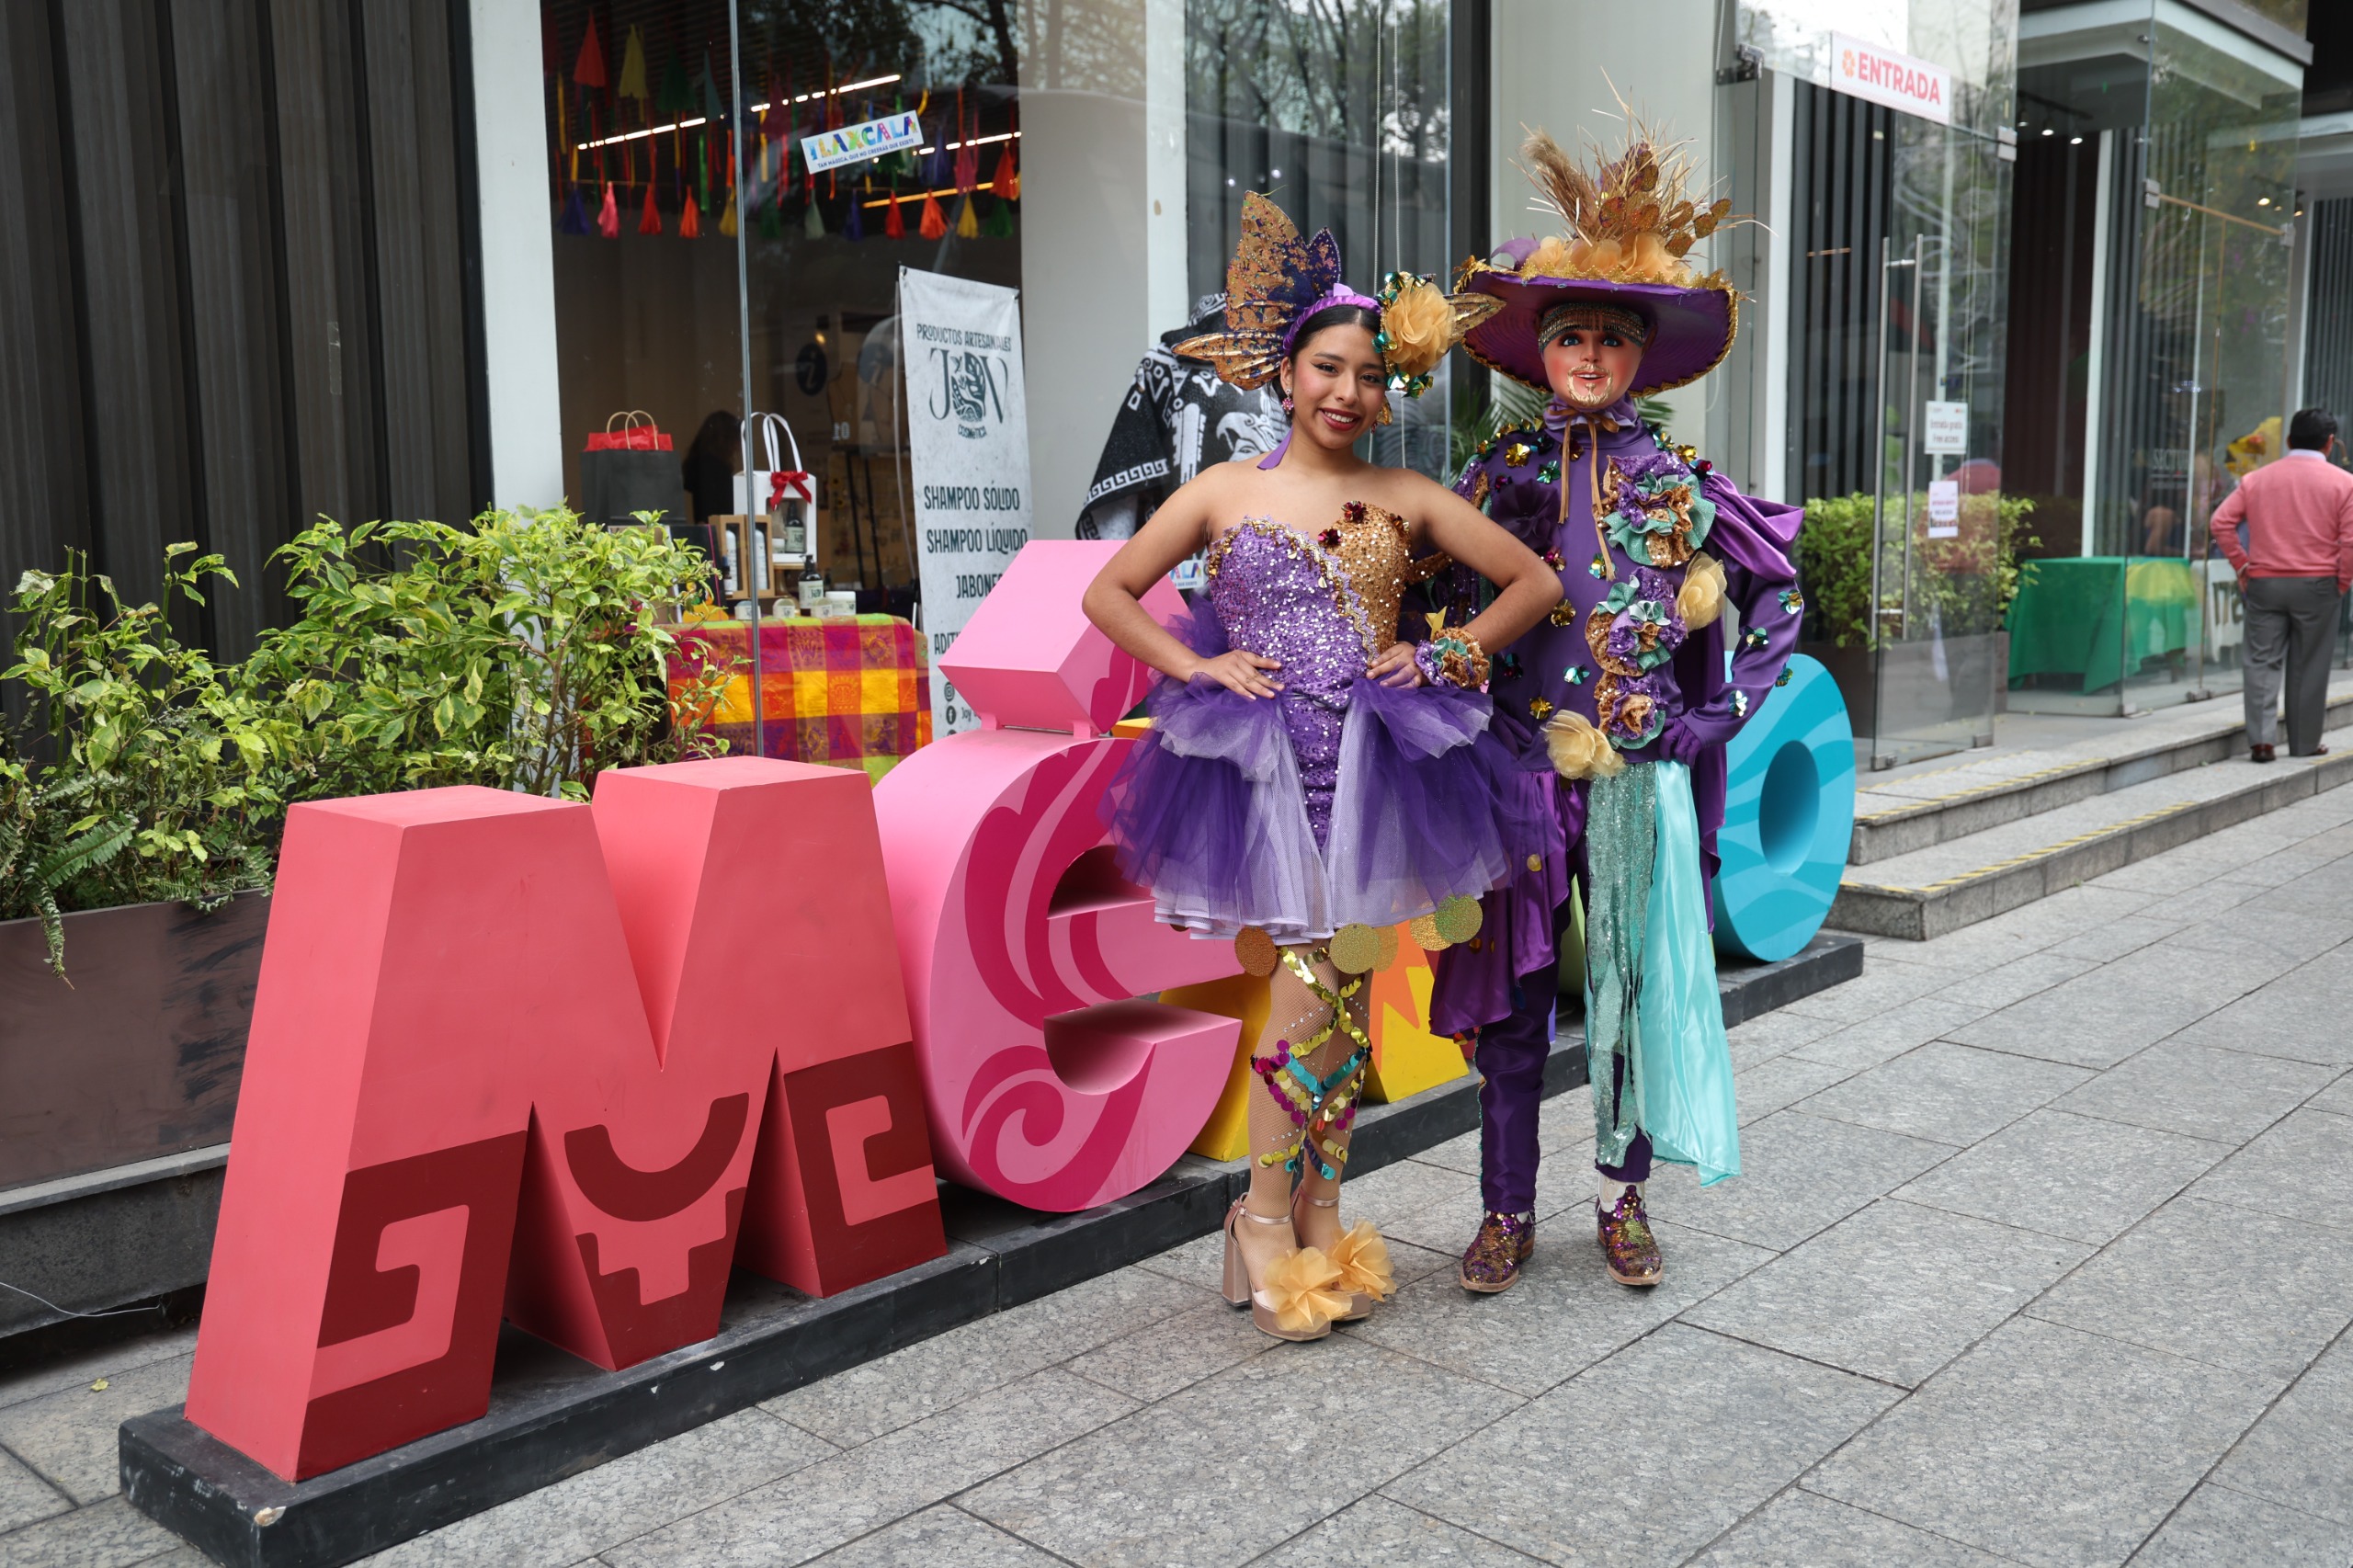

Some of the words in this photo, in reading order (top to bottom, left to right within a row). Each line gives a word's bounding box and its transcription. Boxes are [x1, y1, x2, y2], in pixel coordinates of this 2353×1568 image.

[1859, 51, 1940, 105] ENTRADA
[805, 115, 917, 161] TLAXCALA
[916, 324, 962, 346] PRODUCTOS
[964, 331, 1012, 352] ARTESANALES
[924, 485, 980, 510] SHAMPOO
[983, 480, 1020, 511] SÓLIDO
[926, 528, 983, 553] SHAMPOO
[985, 521, 1028, 555] LÍQUIDO
[956, 574, 1003, 598] JABONE
